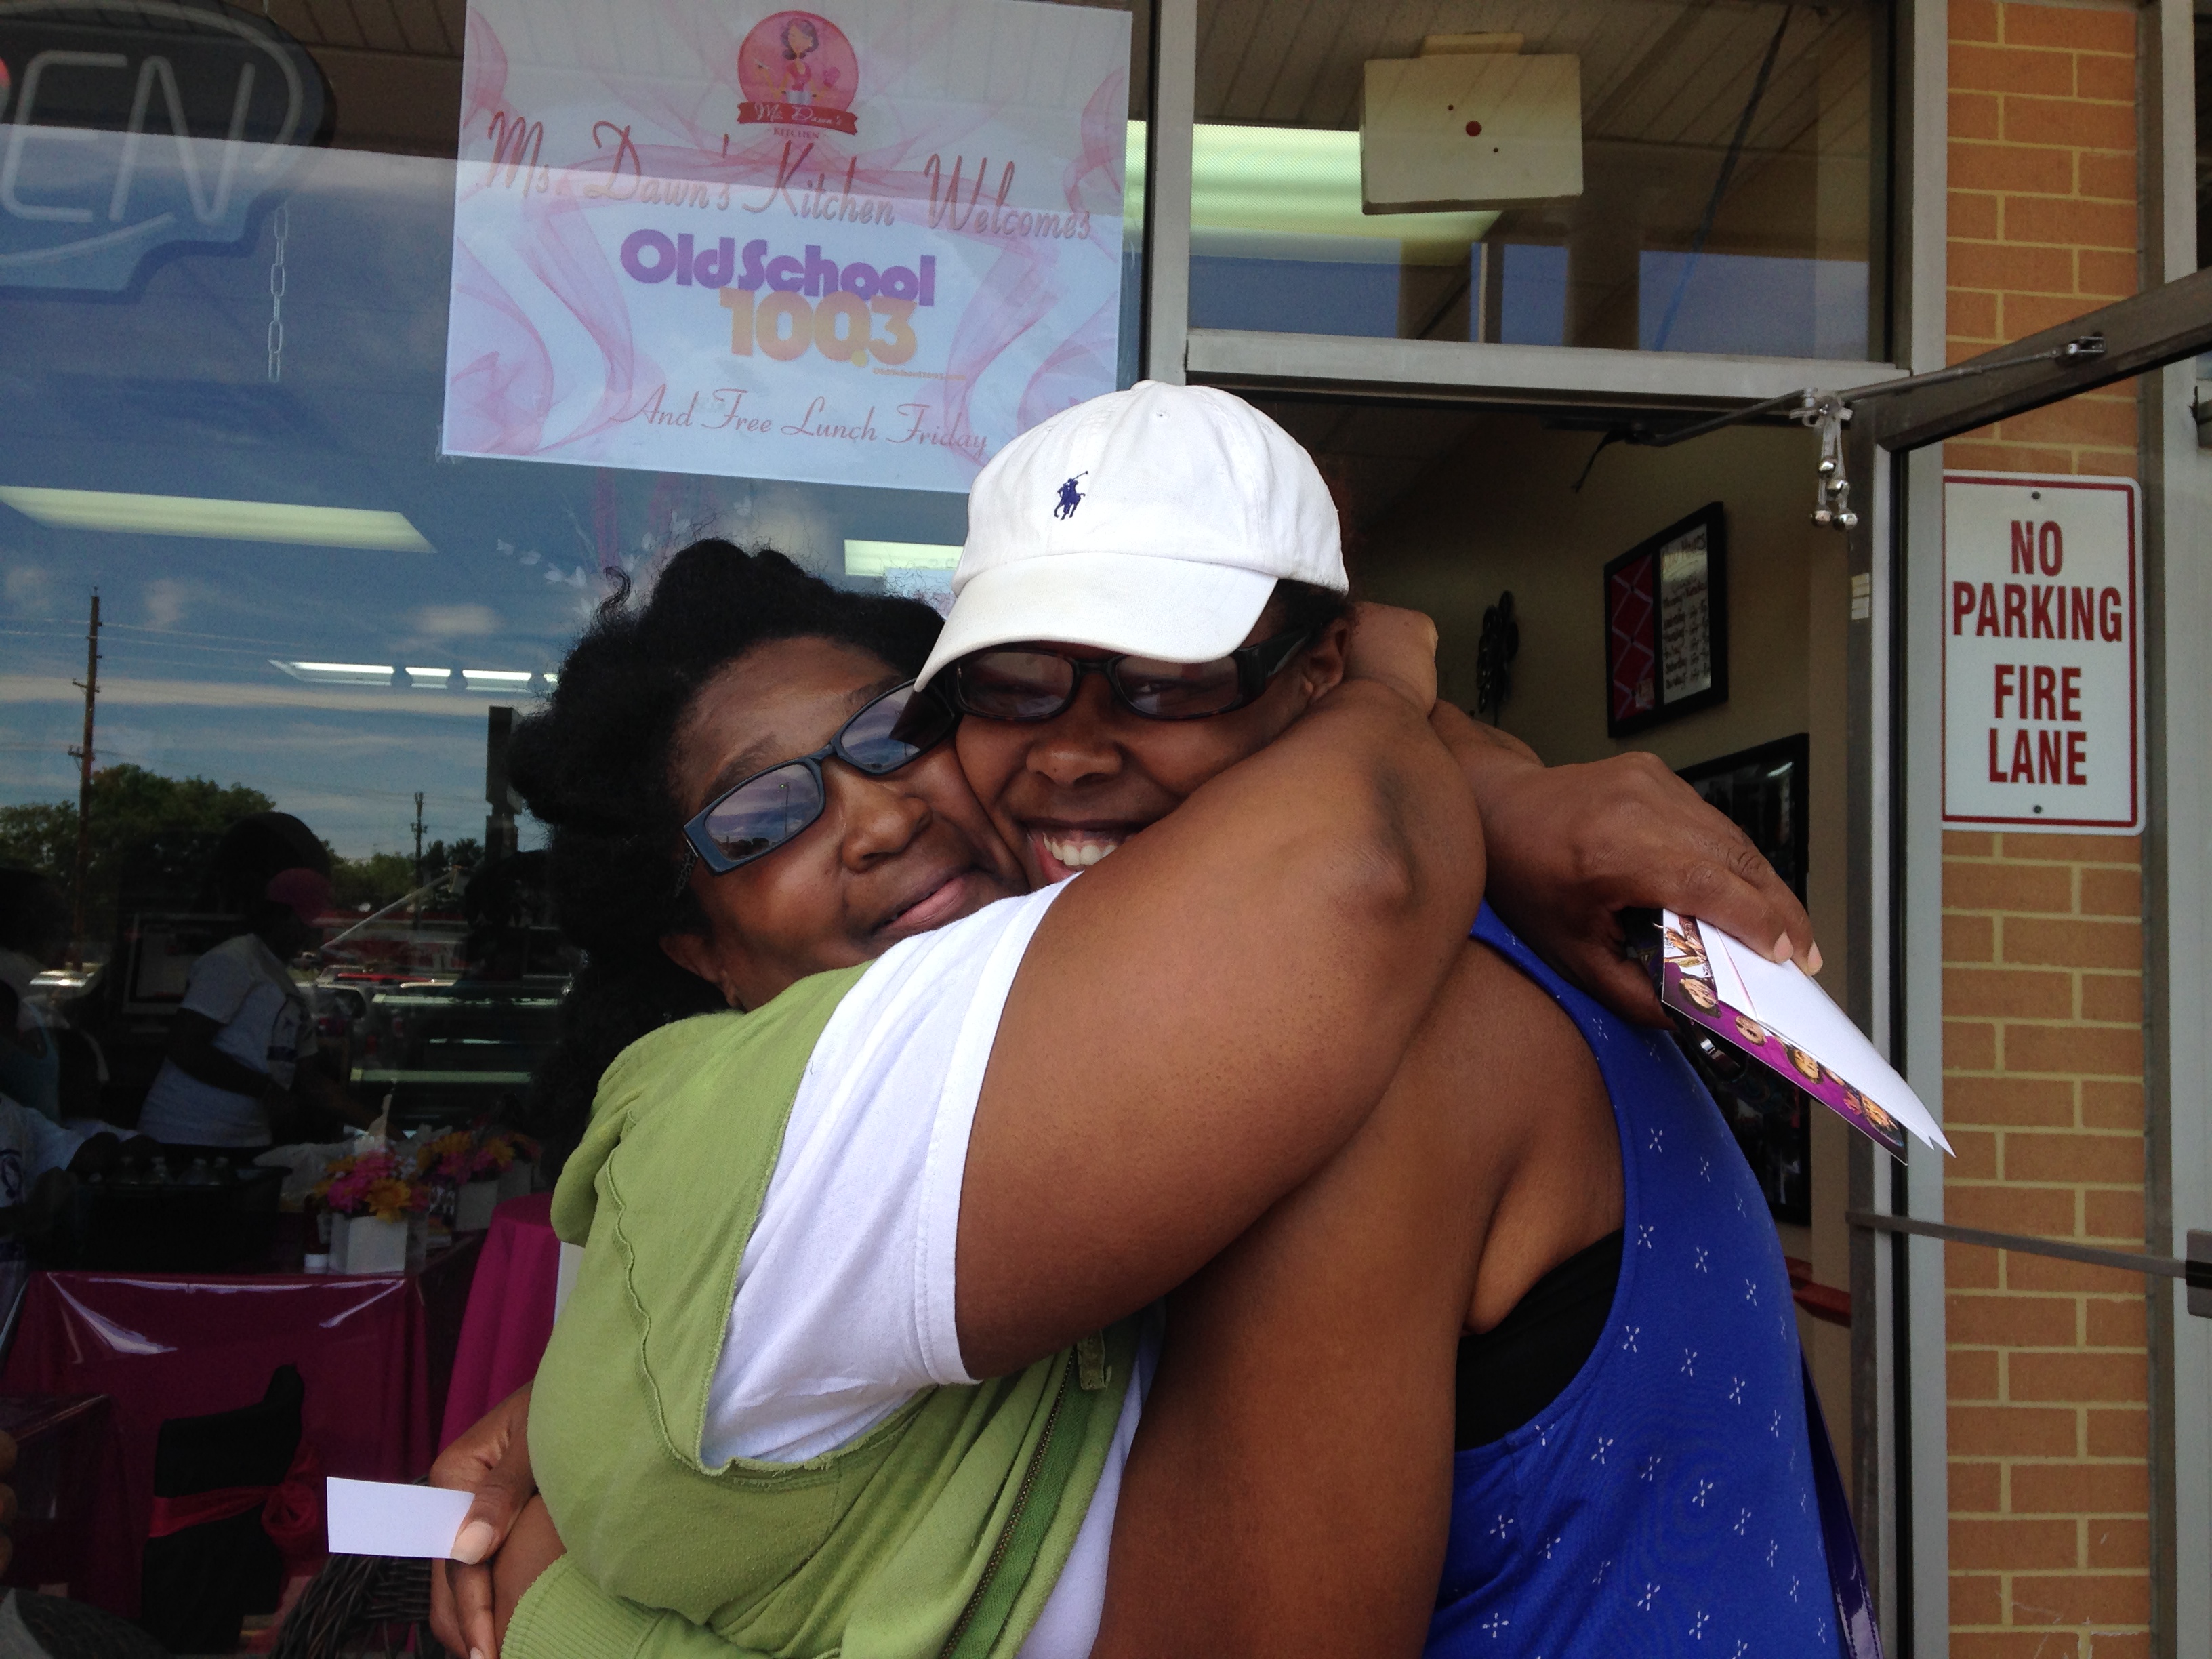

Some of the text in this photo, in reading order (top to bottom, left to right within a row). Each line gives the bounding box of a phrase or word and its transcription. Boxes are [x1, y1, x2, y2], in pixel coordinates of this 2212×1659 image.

[583, 120, 731, 211] Dawn's
[741, 140, 895, 226] Kitchen
[924, 153, 1091, 240] Welcomes
[610, 383, 988, 453] And Free Lunch Friday
[2011, 520, 2063, 577] NO
[1952, 581, 2123, 642] PARKING
[1994, 663, 2082, 722] FIRE
[1988, 727, 2087, 786] LANE
